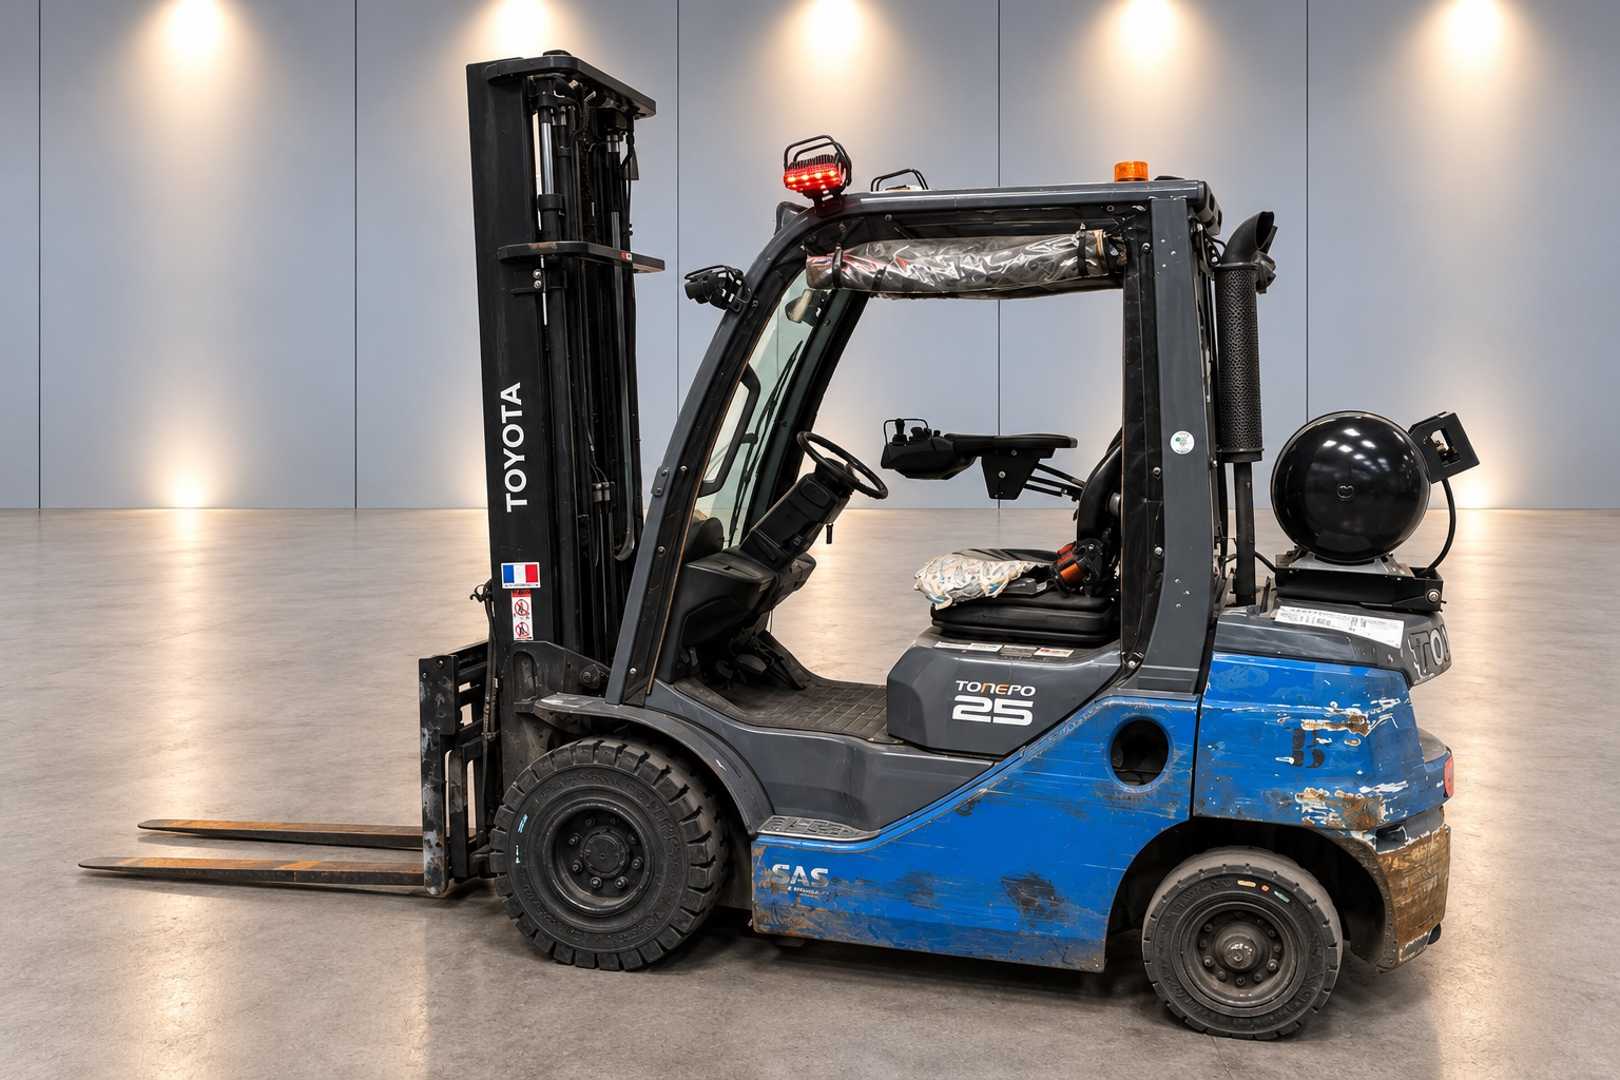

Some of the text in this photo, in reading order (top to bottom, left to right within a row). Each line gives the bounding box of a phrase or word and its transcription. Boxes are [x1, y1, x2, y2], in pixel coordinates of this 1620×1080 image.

[500, 382, 528, 512] TOYOTA
[1408, 624, 1449, 675] TO
[952, 695, 1034, 726] 25
